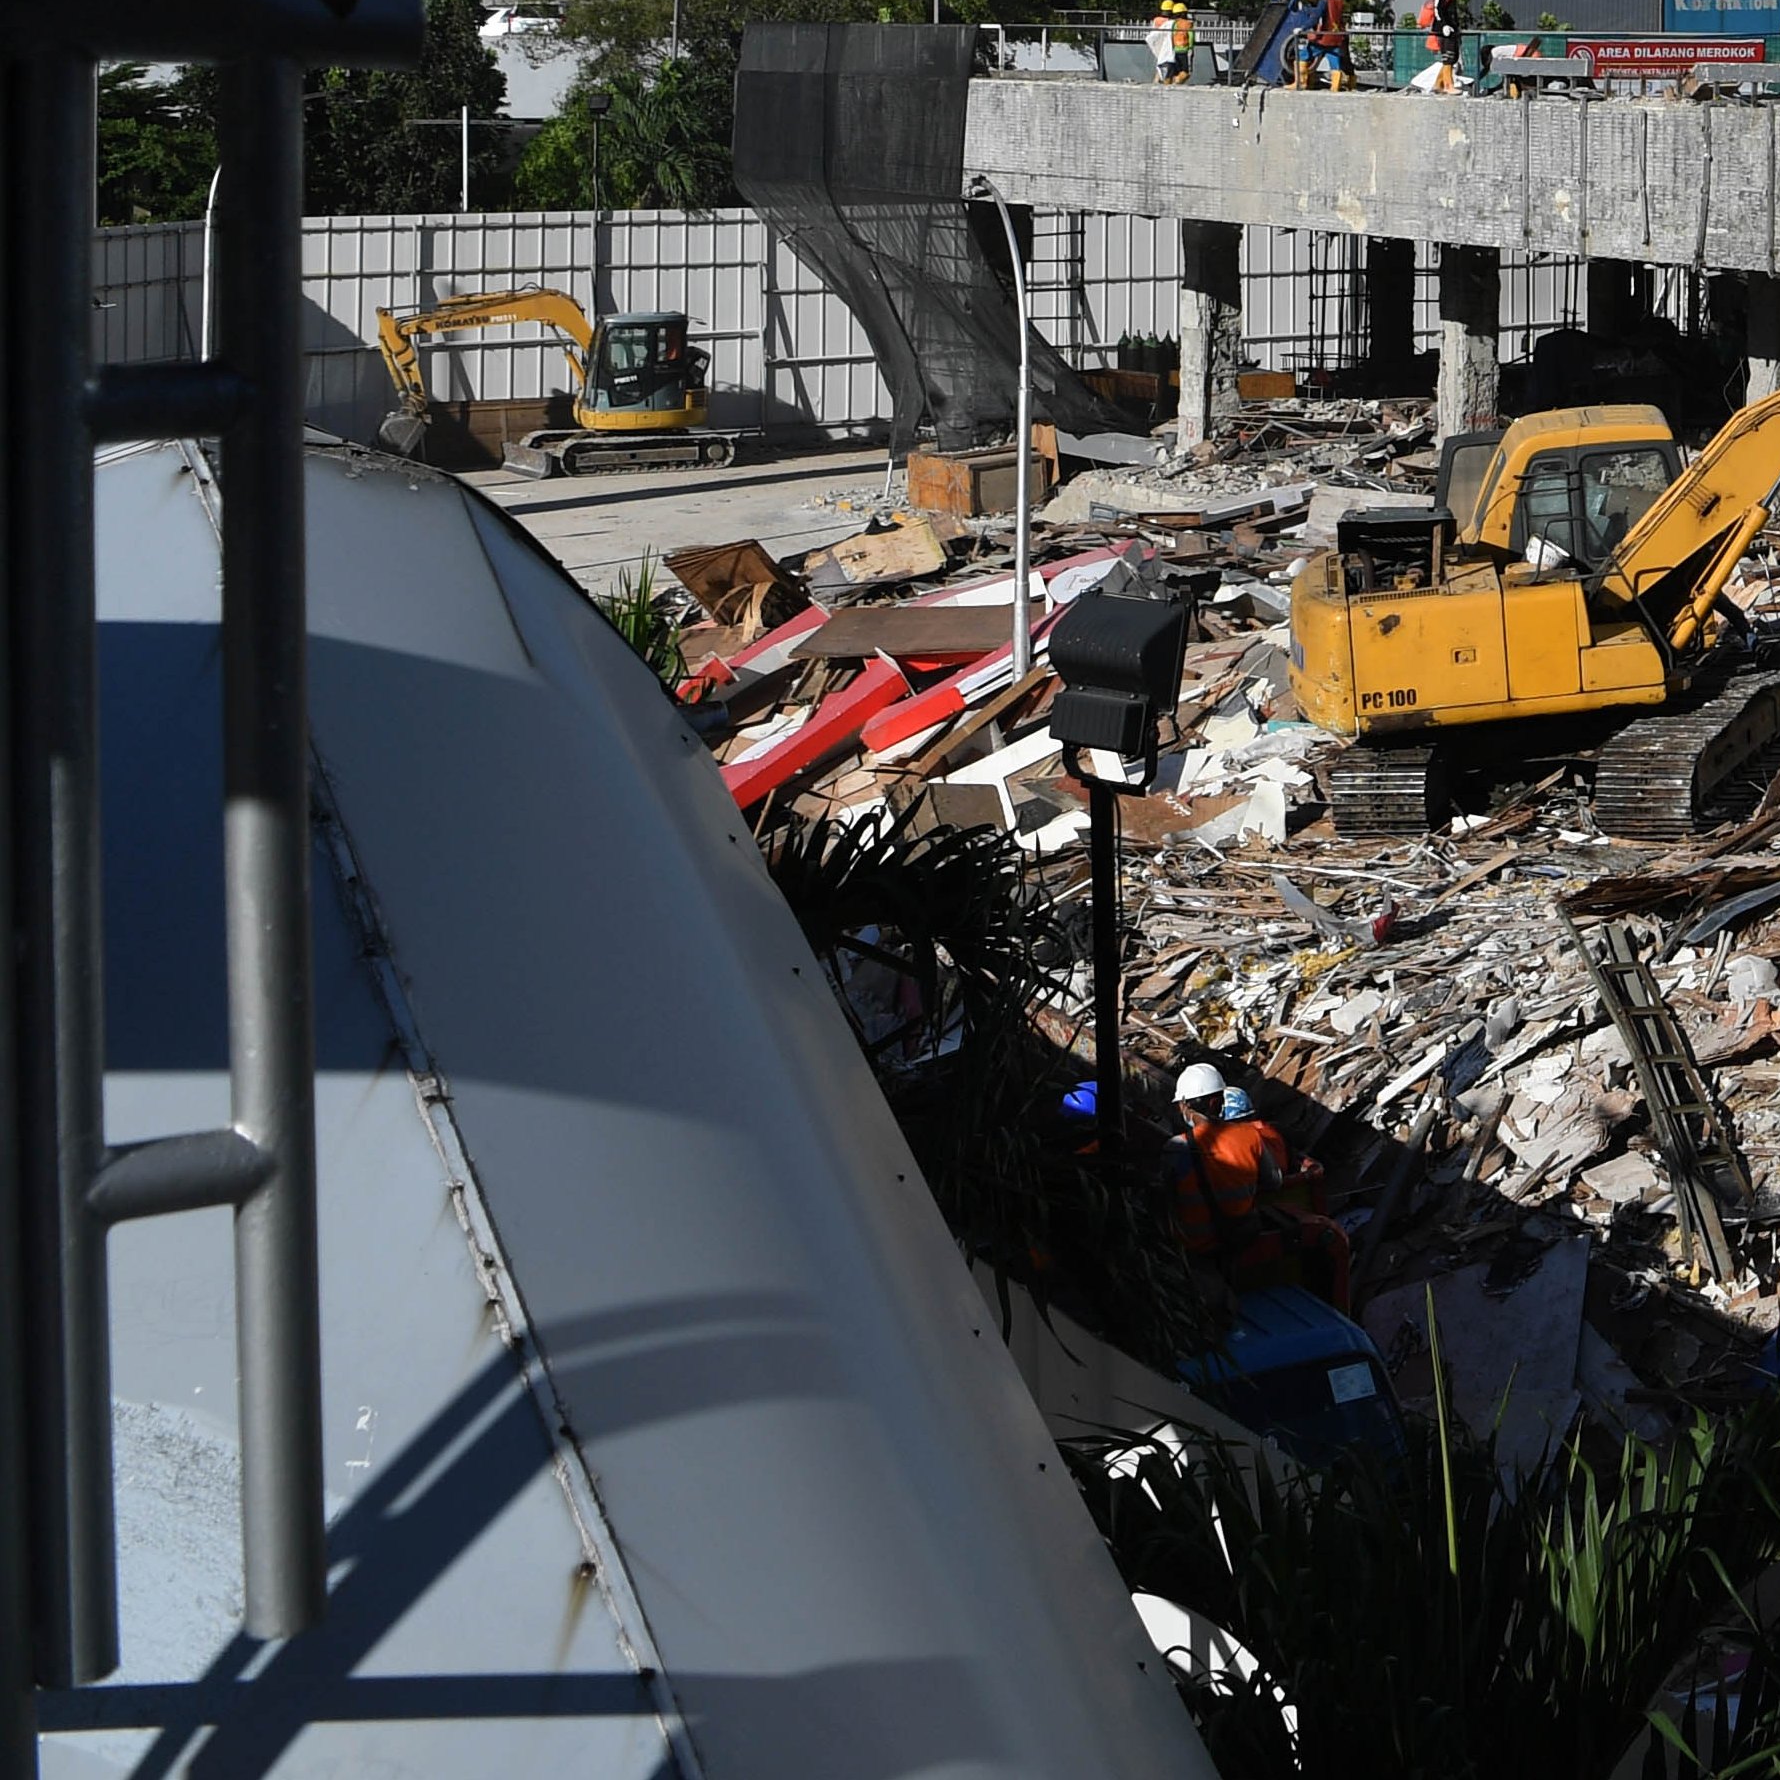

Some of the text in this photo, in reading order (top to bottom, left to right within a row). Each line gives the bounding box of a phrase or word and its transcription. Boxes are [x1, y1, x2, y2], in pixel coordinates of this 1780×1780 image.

[1598, 47, 1755, 58] AREA DILARANG MEROKOK
[1362, 689, 1417, 710] PC 100
